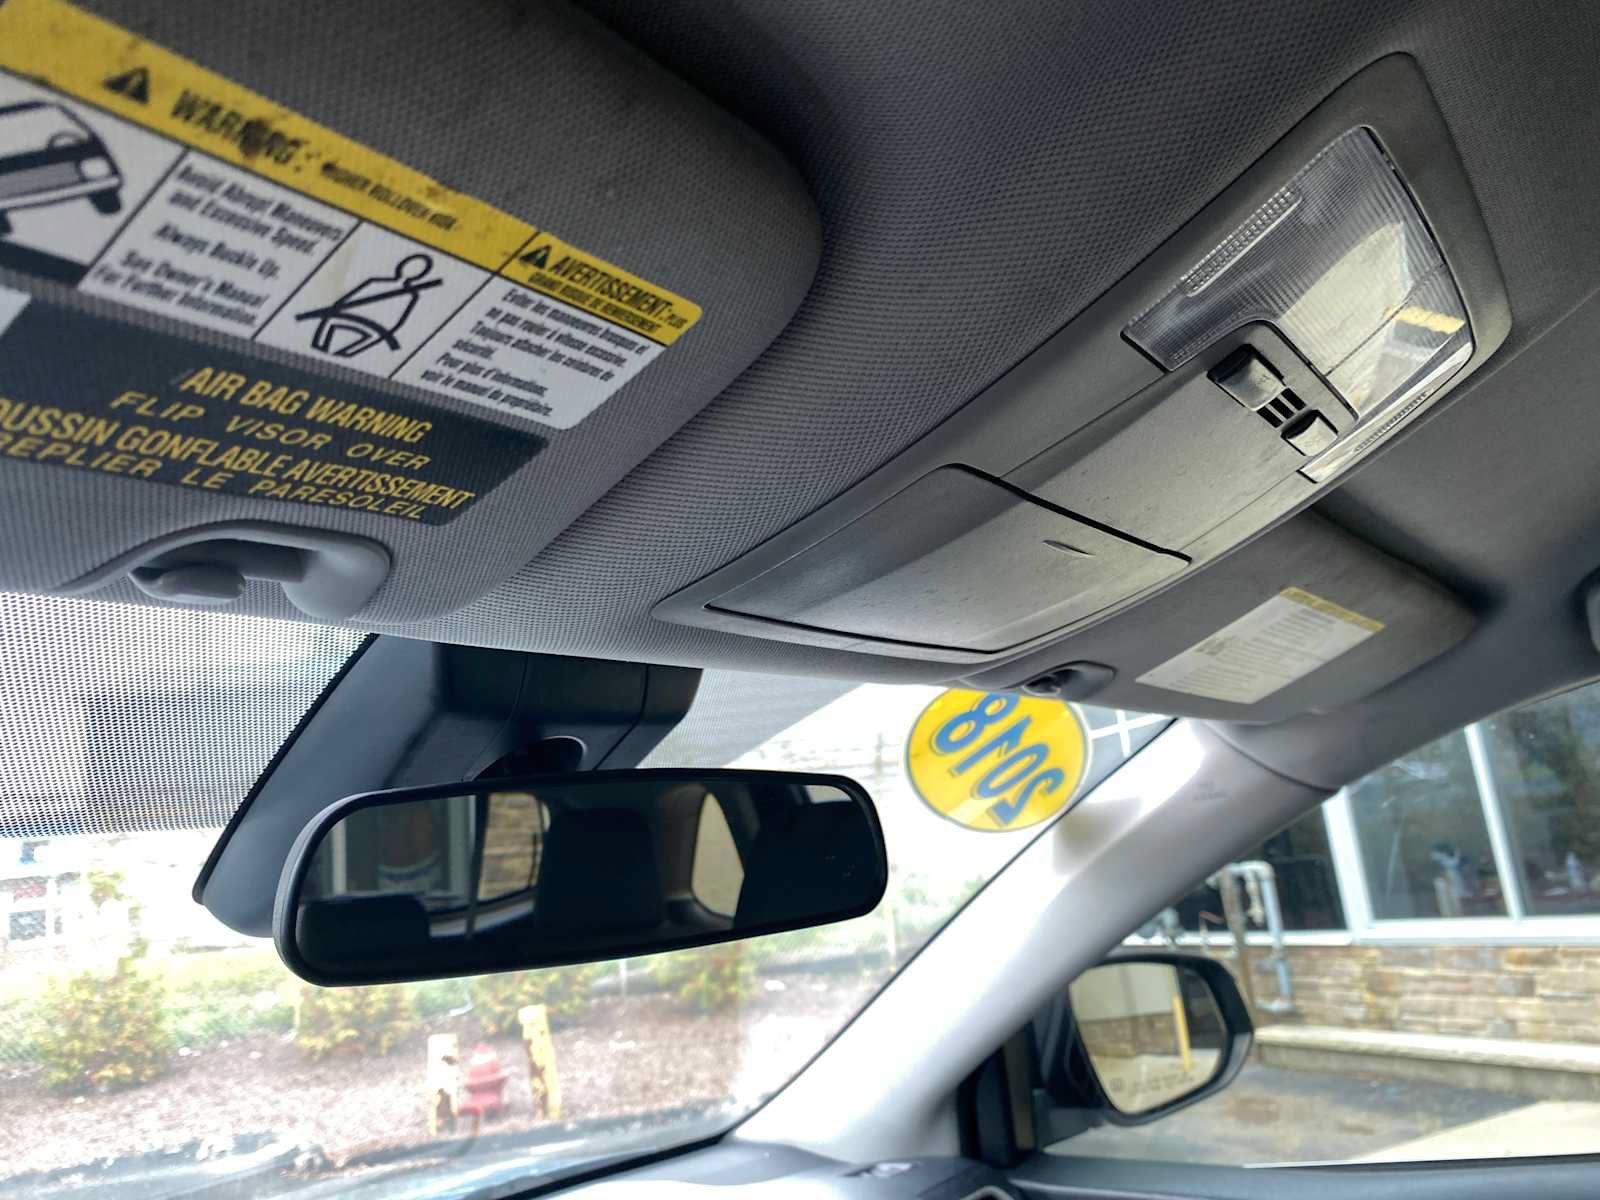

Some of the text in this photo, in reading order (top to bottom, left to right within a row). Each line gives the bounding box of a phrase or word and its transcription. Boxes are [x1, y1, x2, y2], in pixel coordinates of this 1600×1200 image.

[171, 88, 303, 171] WARNG:
[548, 255, 674, 321] AVERTISSEMENT:
[110, 390, 431, 472] FLIP VISOR OVER
[180, 367, 433, 443] AIR BAG WARNING
[116, 425, 292, 478] GONFLABLE
[287, 461, 476, 510] AVERTISSEMENT
[181, 467, 238, 489] LE
[249, 479, 426, 519] PARESOLEIL
